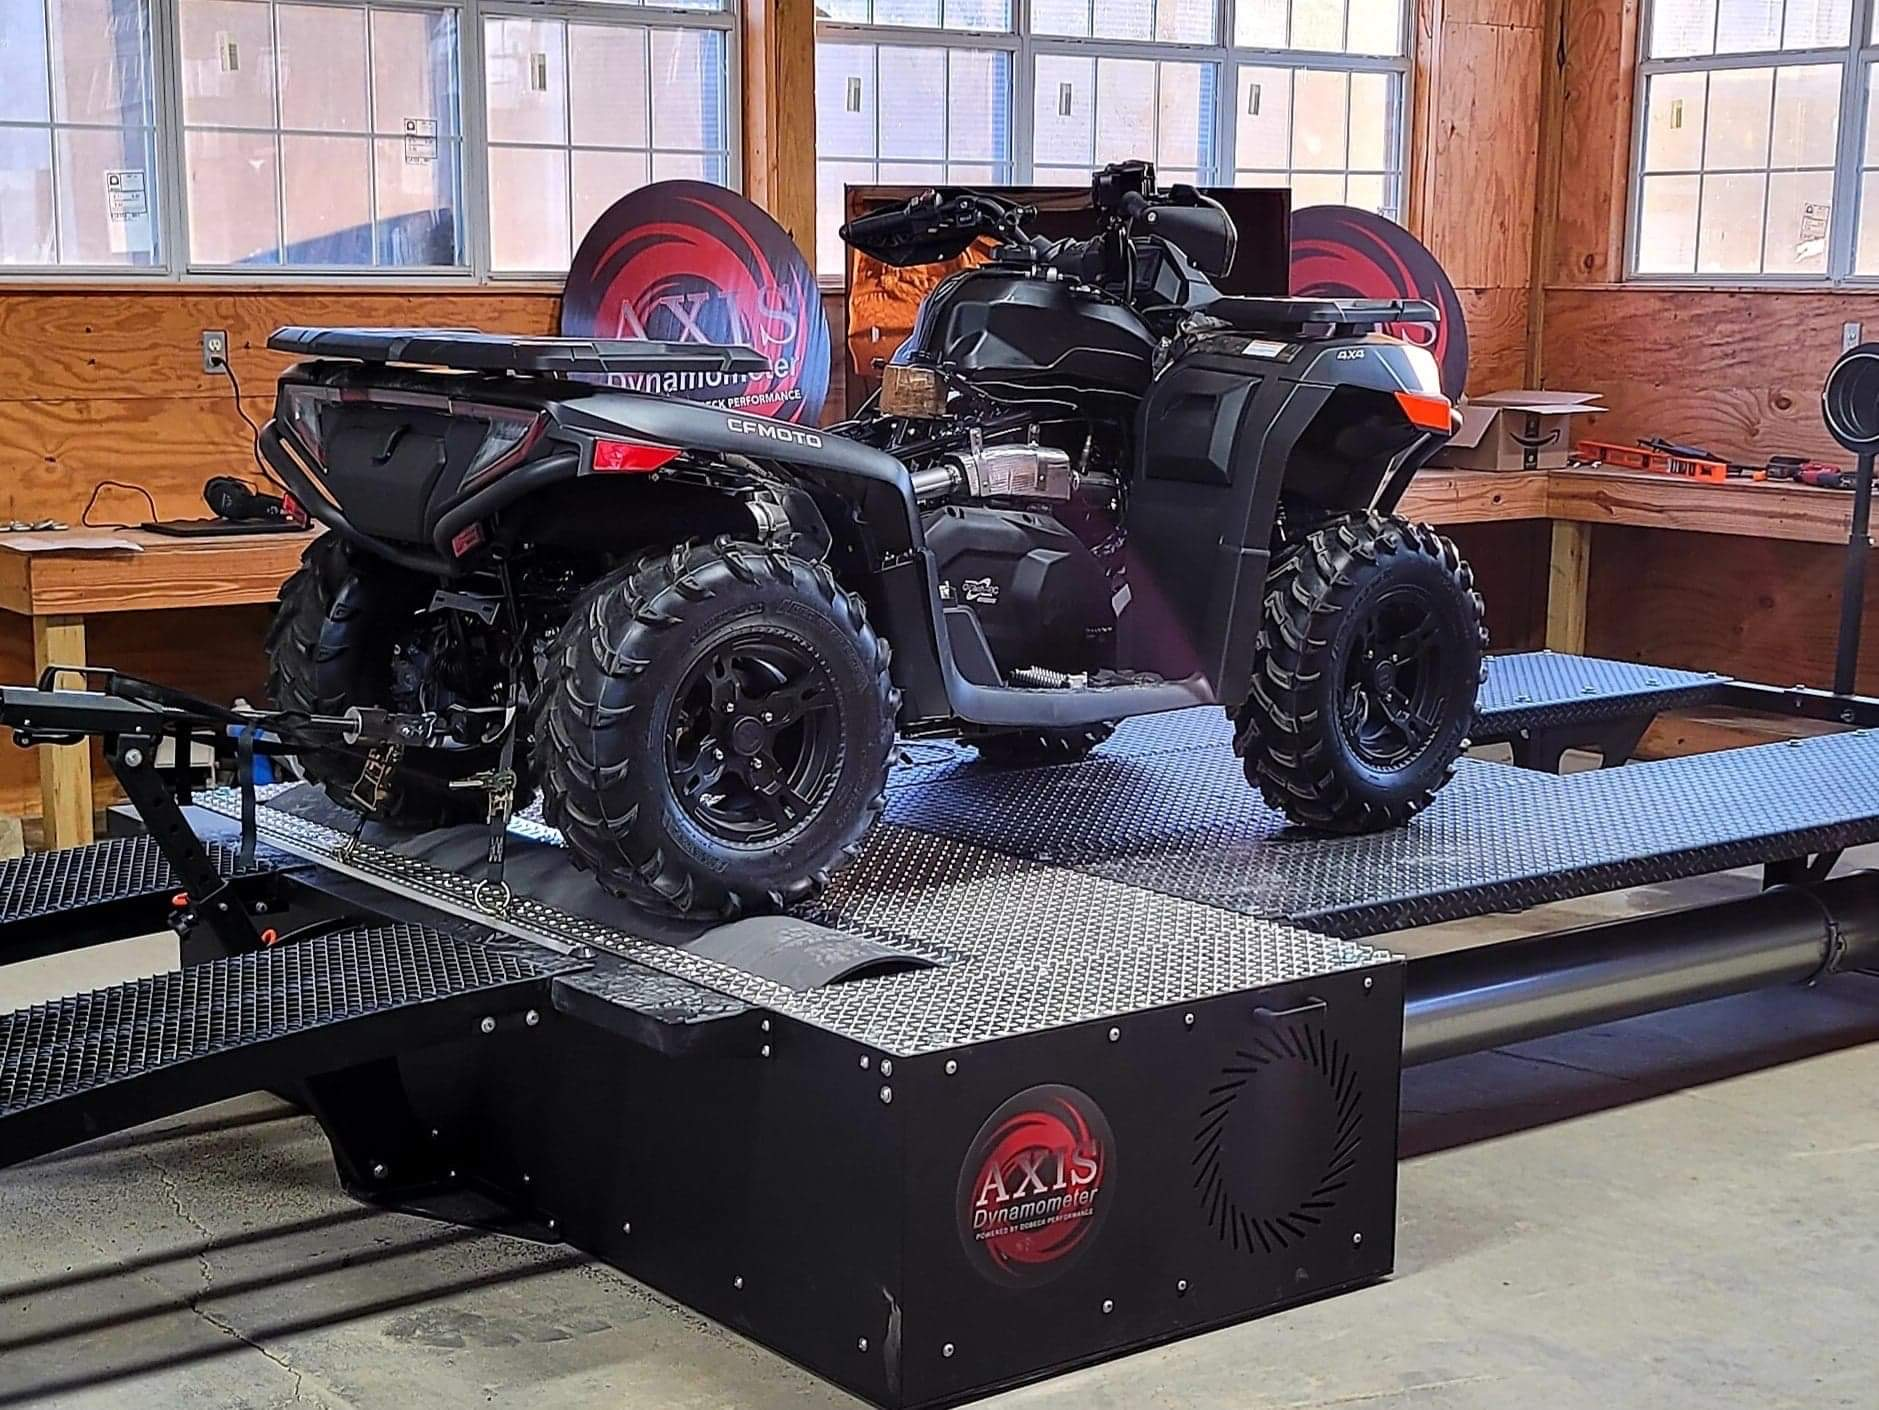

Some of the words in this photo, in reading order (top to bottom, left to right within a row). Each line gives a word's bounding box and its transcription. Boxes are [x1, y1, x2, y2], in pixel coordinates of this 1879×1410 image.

[728, 389, 802, 408] PERFORMANCE
[727, 418, 822, 448] CFMOTO
[976, 1139, 1098, 1207] AXIS
[973, 1187, 1098, 1230] Dynamometer
